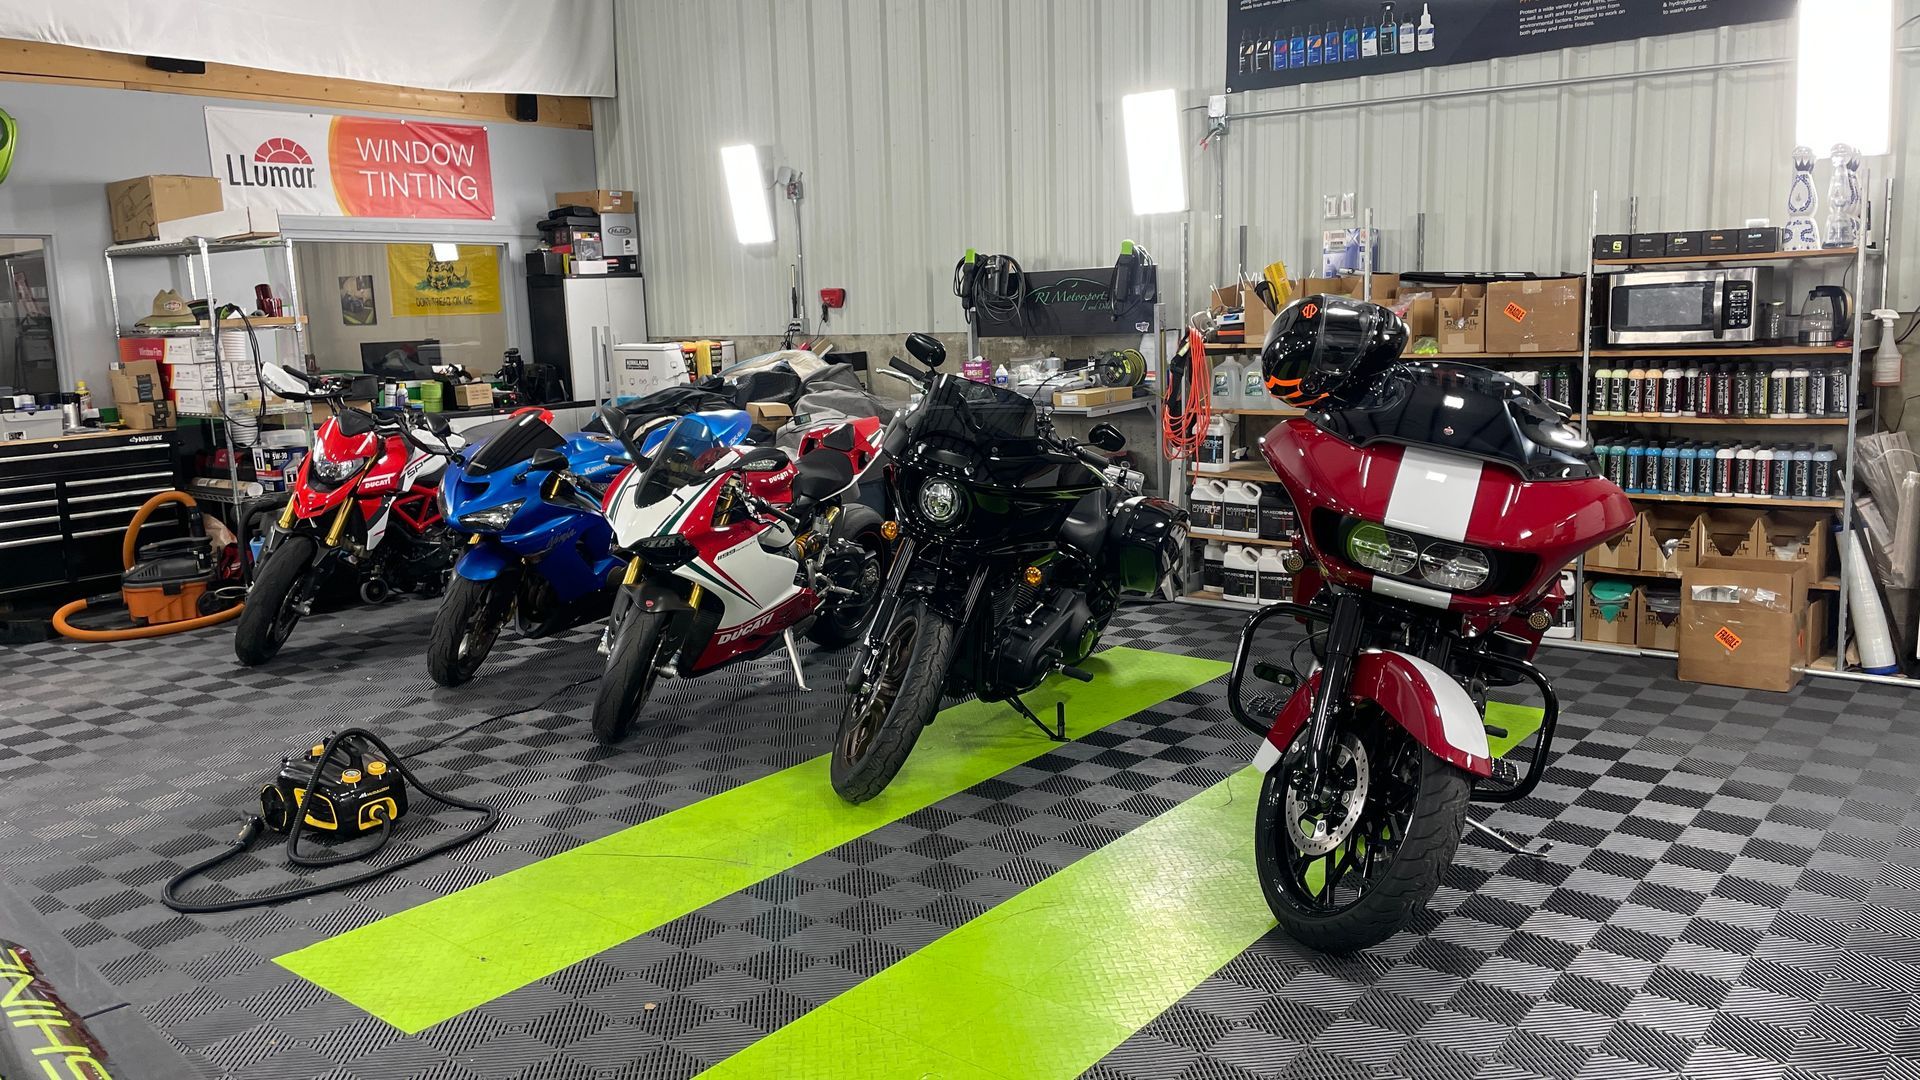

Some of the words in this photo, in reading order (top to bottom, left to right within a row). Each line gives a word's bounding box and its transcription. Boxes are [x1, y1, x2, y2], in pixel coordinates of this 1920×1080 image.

[1520, 20, 1554, 29] environmental
[1574, 13, 1598, 21] Designed
[356, 138, 474, 167] WINDOW
[226, 154, 315, 188] LLumar
[359, 171, 478, 200] TINTING
[432, 296, 451, 306] TREAD
[453, 297, 461, 305] ON
[464, 295, 473, 304] ME
[1506, 304, 1525, 321] FRAGILE
[407, 462, 423, 478] SP
[768, 470, 788, 483] DUCATI
[365, 477, 391, 488] DUCATI
[717, 613, 775, 645] DUCATI
[1717, 629, 1740, 649] FRAGILE
